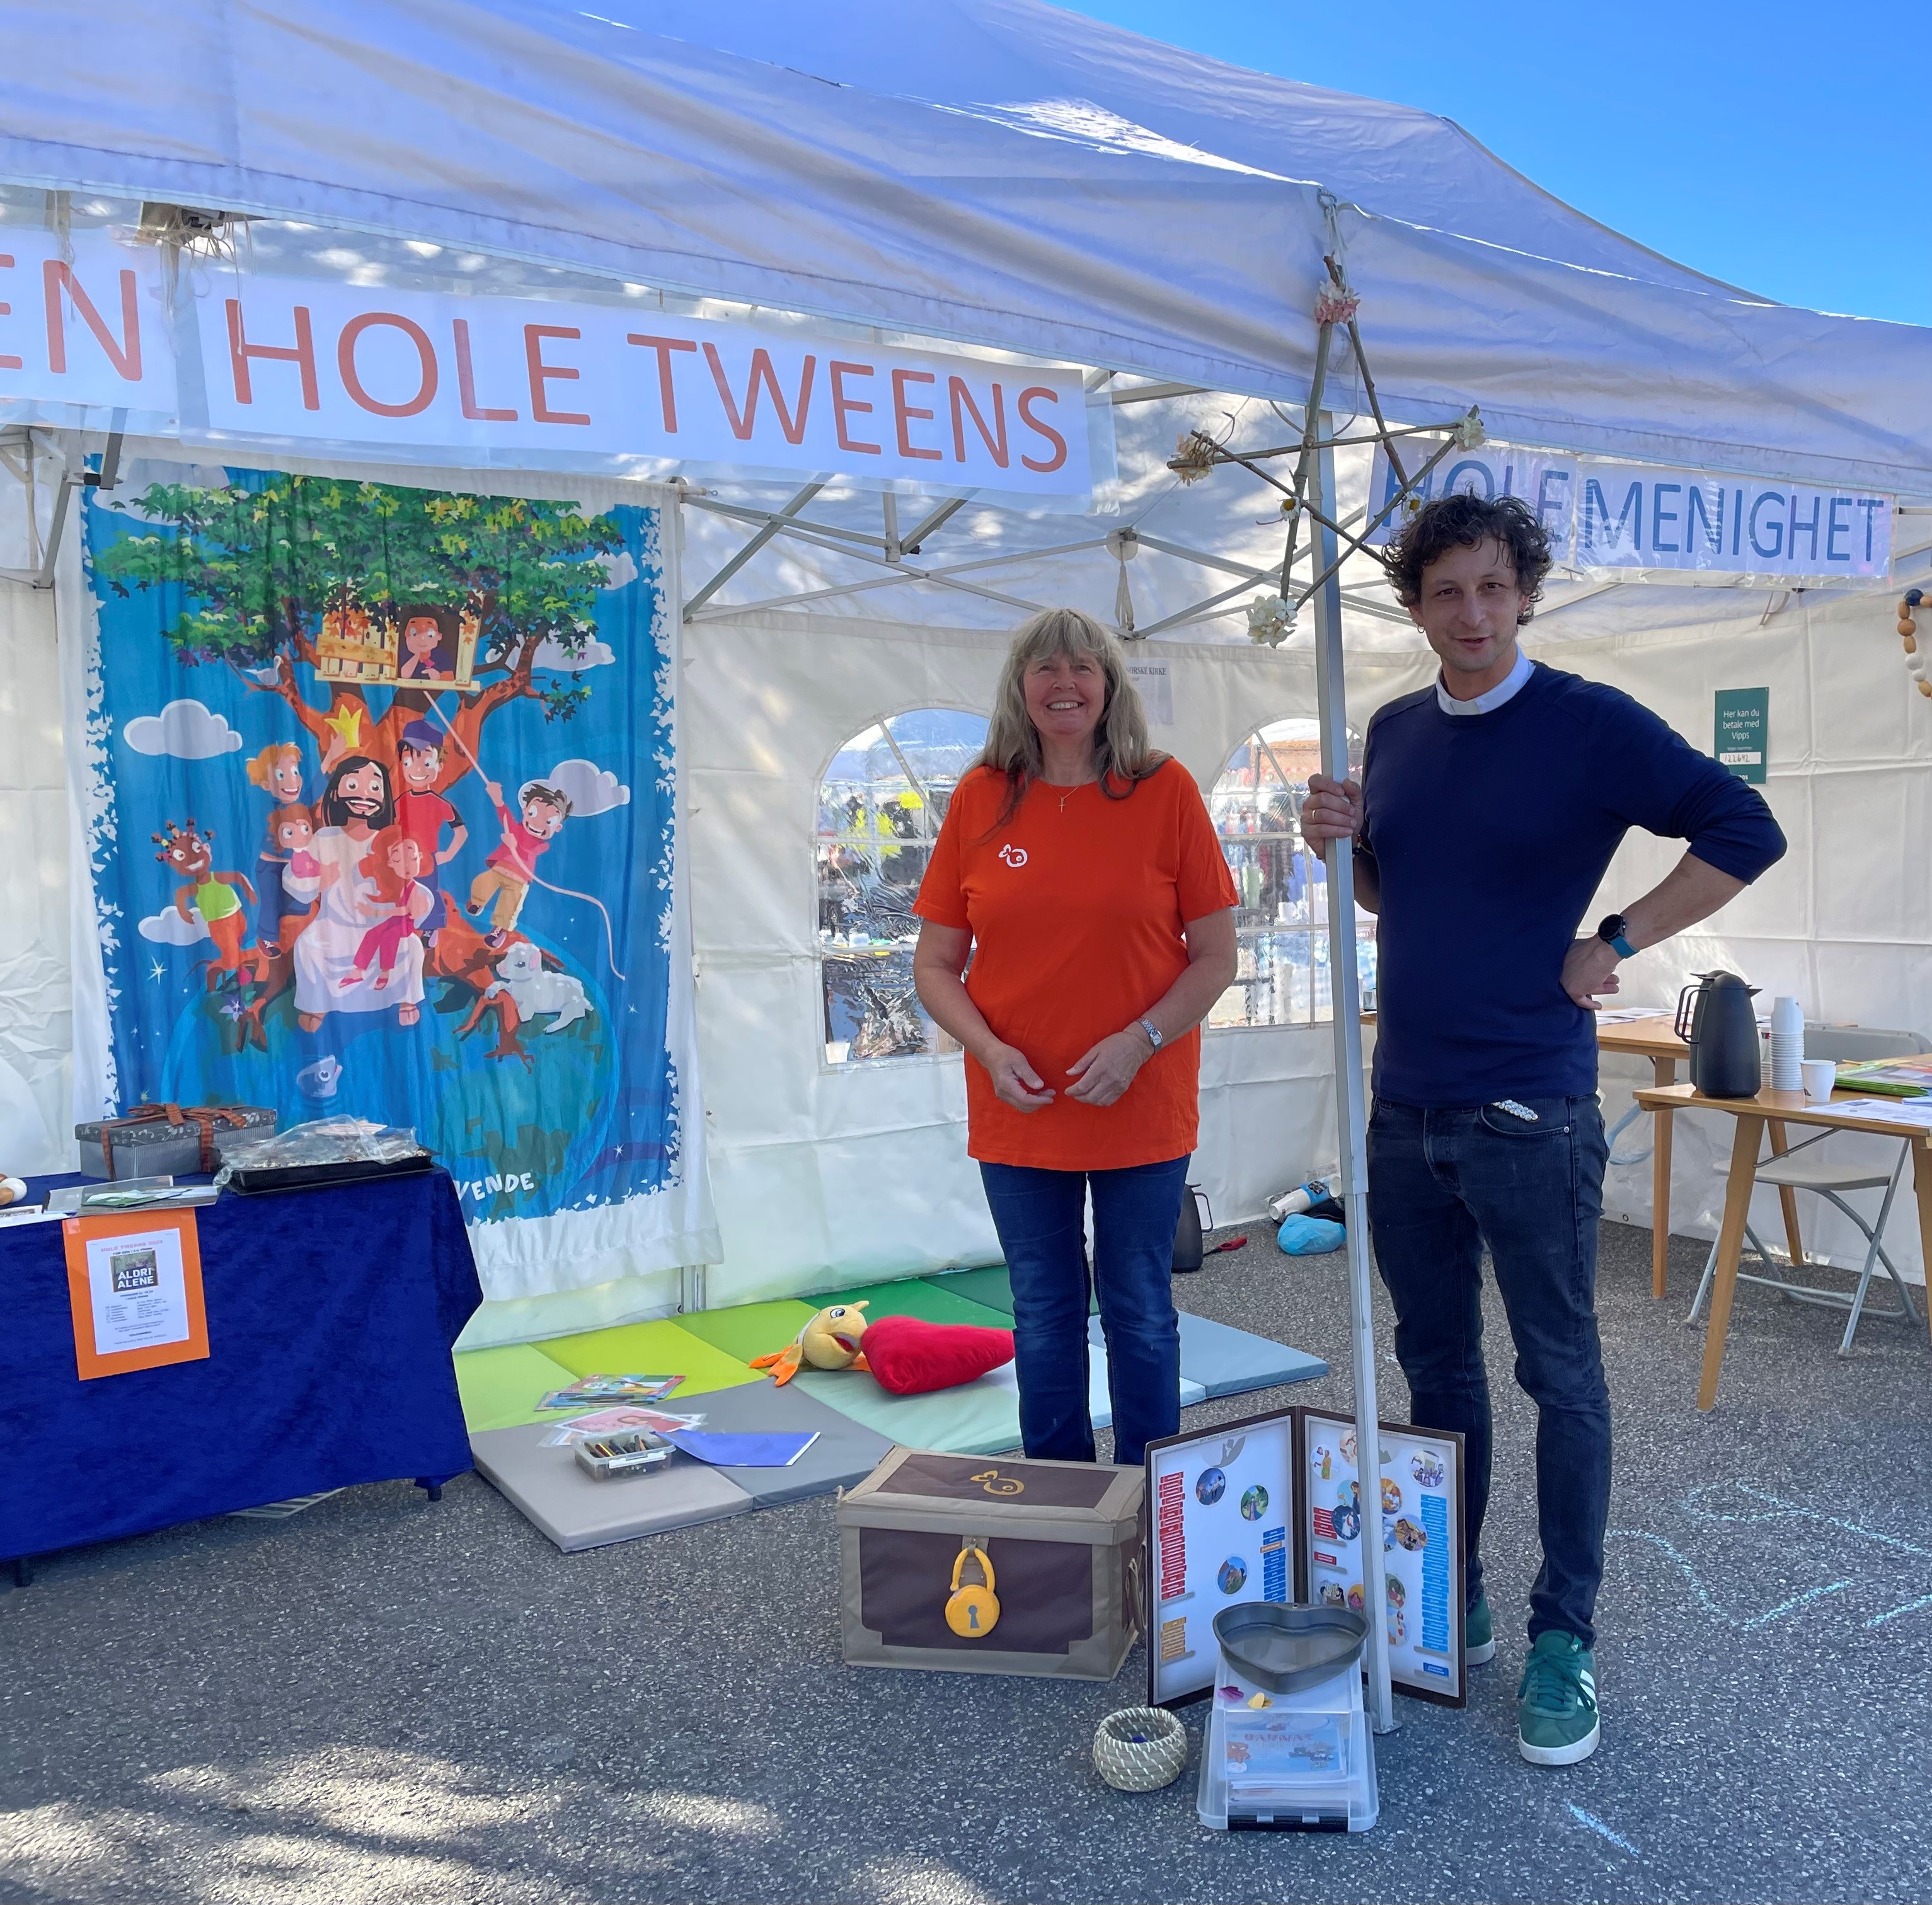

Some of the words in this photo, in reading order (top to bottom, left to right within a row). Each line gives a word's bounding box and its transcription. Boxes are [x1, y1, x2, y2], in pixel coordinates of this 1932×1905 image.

[225, 298, 591, 425] HOLE
[626, 333, 1068, 473] TWEENS
[1584, 479, 1884, 562] MENIGHET
[1737, 709, 1749, 717] kan
[1751, 708, 1759, 717] du
[1723, 720, 1743, 729] betale
[1744, 720, 1759, 728] med
[1731, 731, 1750, 741] Vipps
[452, 1172, 535, 1201] VENDE
[118, 1267, 152, 1280] ALDRI
[117, 1275, 154, 1289] ALENE
